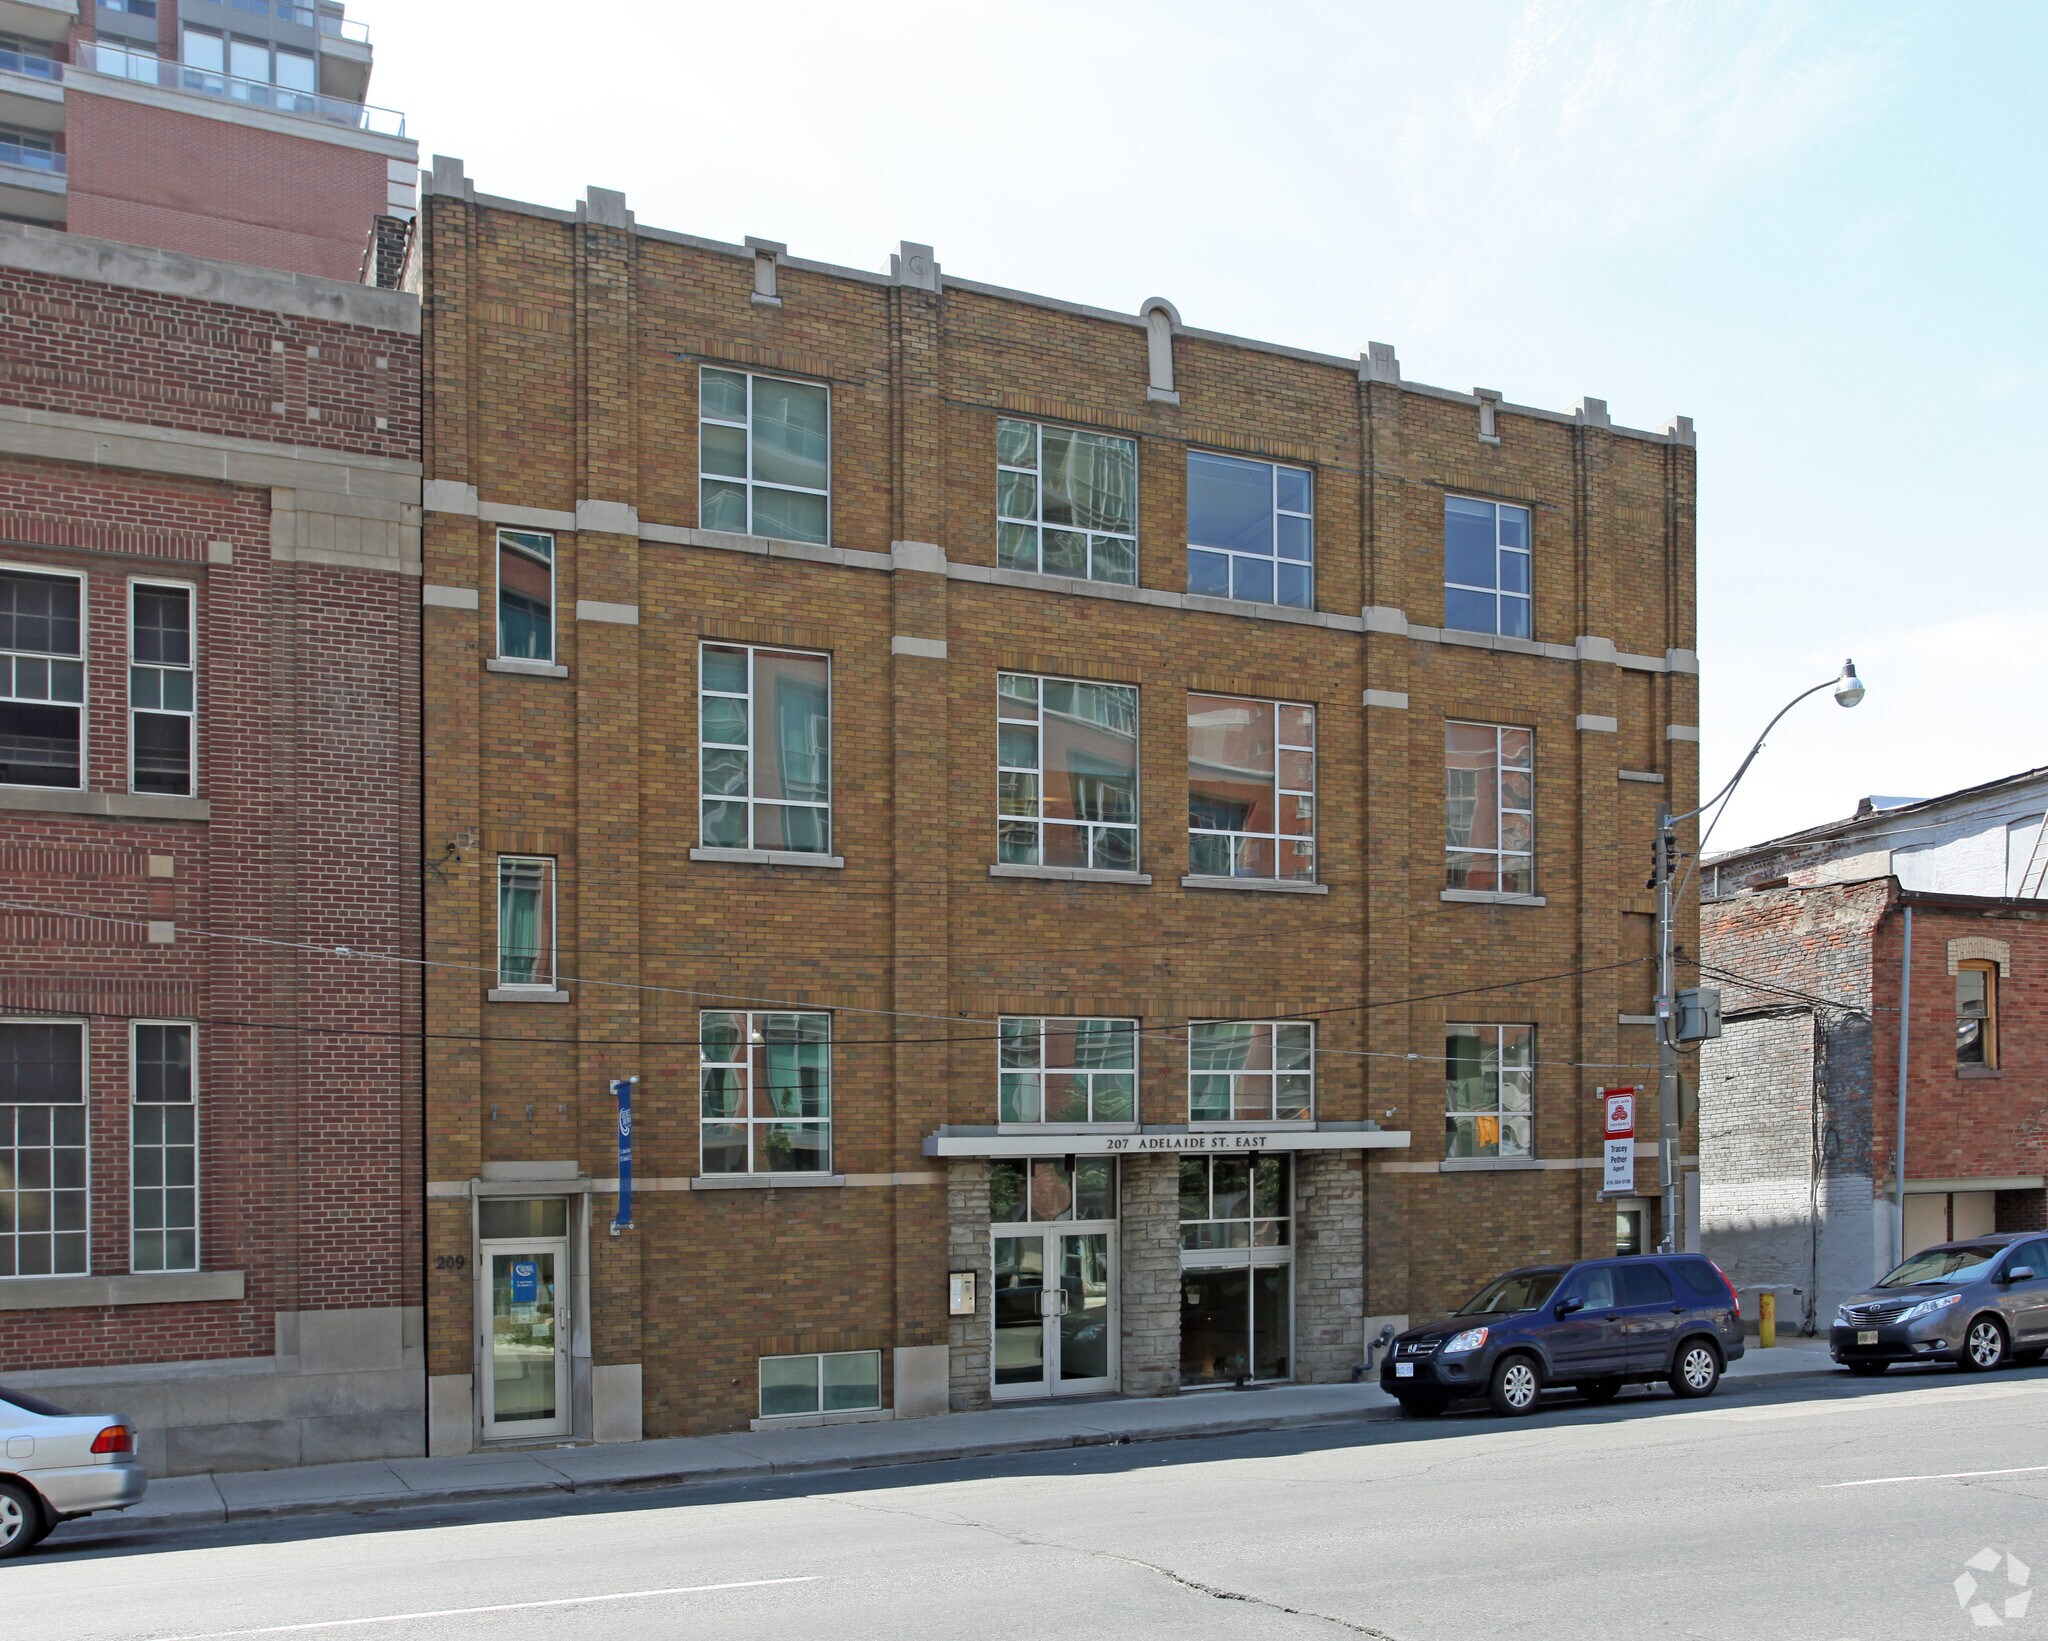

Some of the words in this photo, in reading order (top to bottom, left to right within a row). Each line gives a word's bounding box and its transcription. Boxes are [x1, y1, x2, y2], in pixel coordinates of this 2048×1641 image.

[1107, 1139, 1128, 1149] 207
[1139, 1138, 1205, 1148] ADELAIDE
[1212, 1137, 1230, 1148] ST.
[1236, 1136, 1267, 1147] EAST
[1610, 1145, 1628, 1153] Tracey
[436, 1255, 464, 1270] 209
